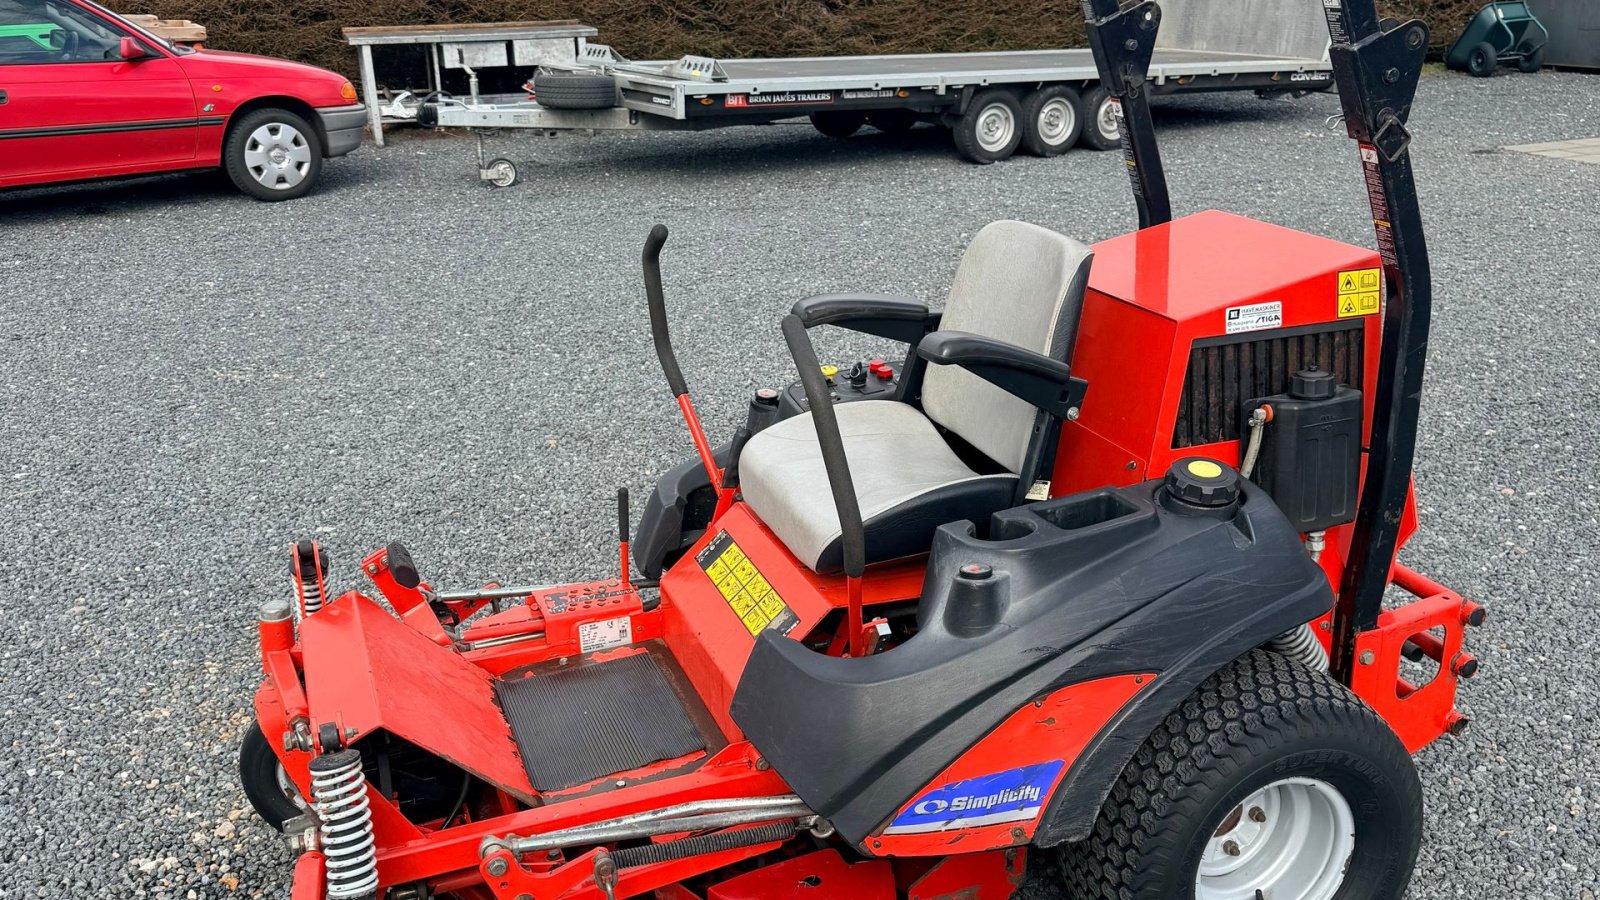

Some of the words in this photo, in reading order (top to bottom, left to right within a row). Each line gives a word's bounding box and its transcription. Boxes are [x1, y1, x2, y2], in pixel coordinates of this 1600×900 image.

[727, 94, 745, 105] BJT
[748, 95, 772, 104] BRIAN
[773, 94, 796, 103] JAMES
[797, 92, 831, 101] TRAILERS
[1343, 755, 1387, 786] TURF
[949, 785, 1041, 811] Simplicity
